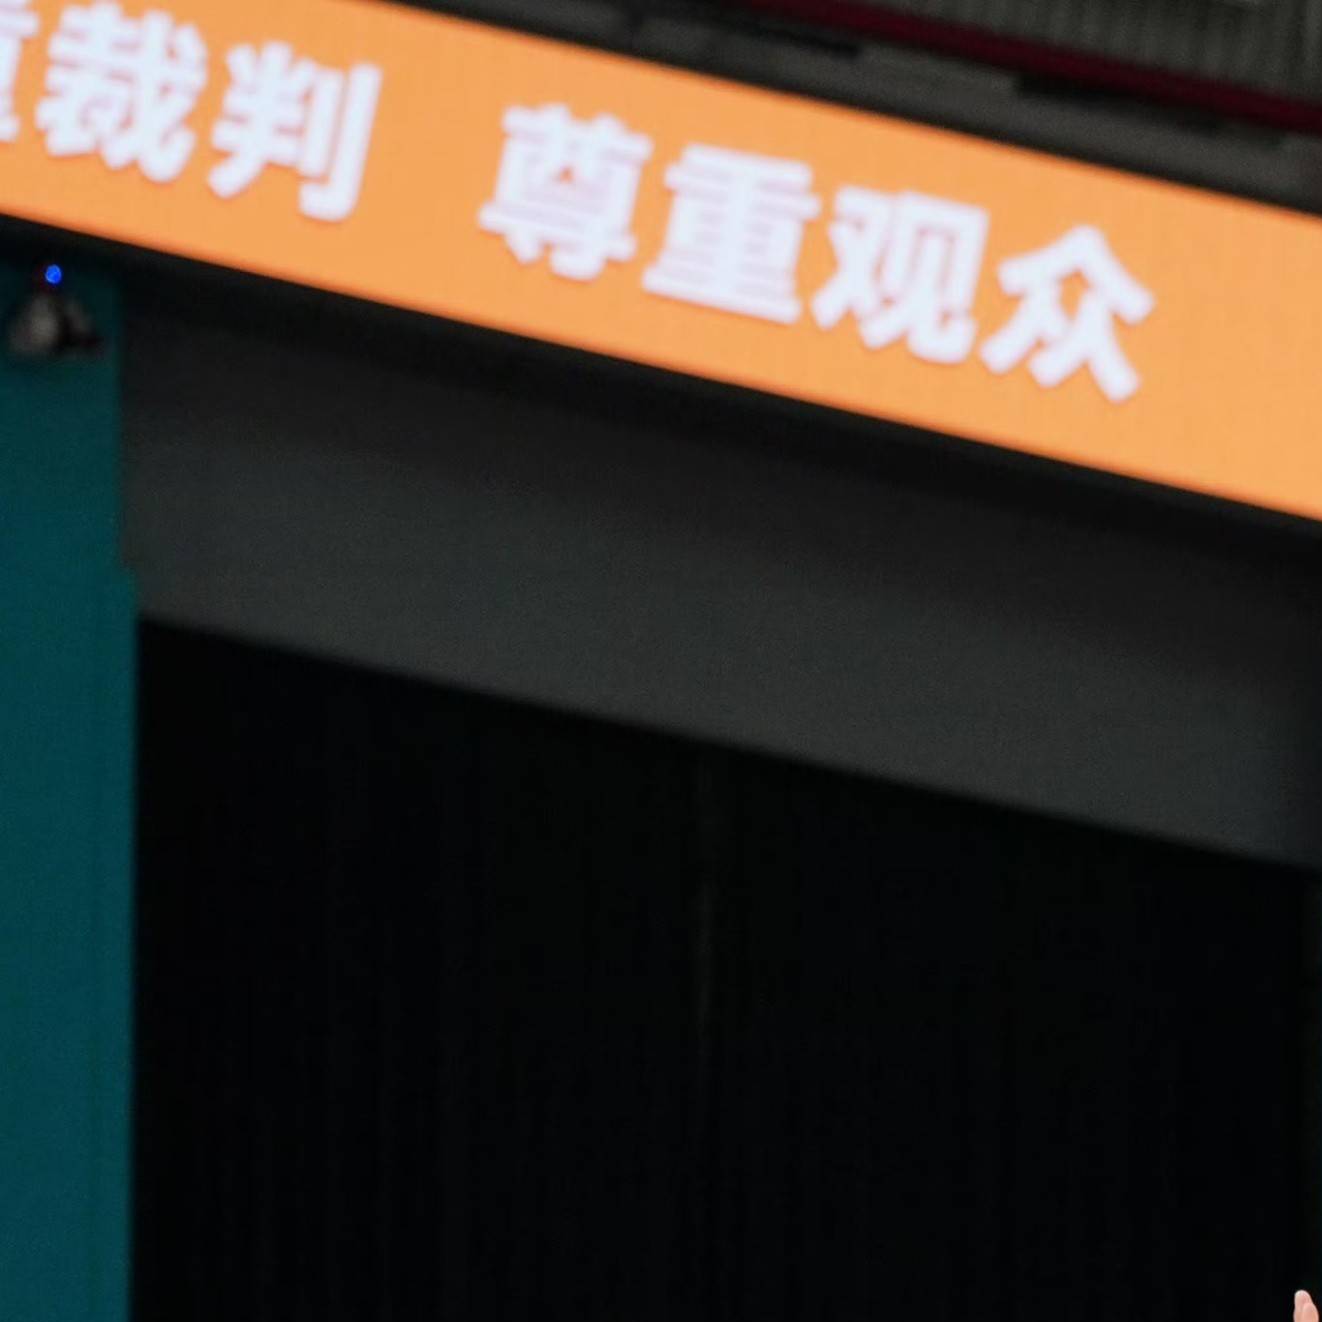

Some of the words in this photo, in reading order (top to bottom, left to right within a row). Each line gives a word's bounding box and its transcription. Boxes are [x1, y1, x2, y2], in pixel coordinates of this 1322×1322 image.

[0, 0, 382, 222] 裁判
[478, 101, 1154, 402] 尊重观众
